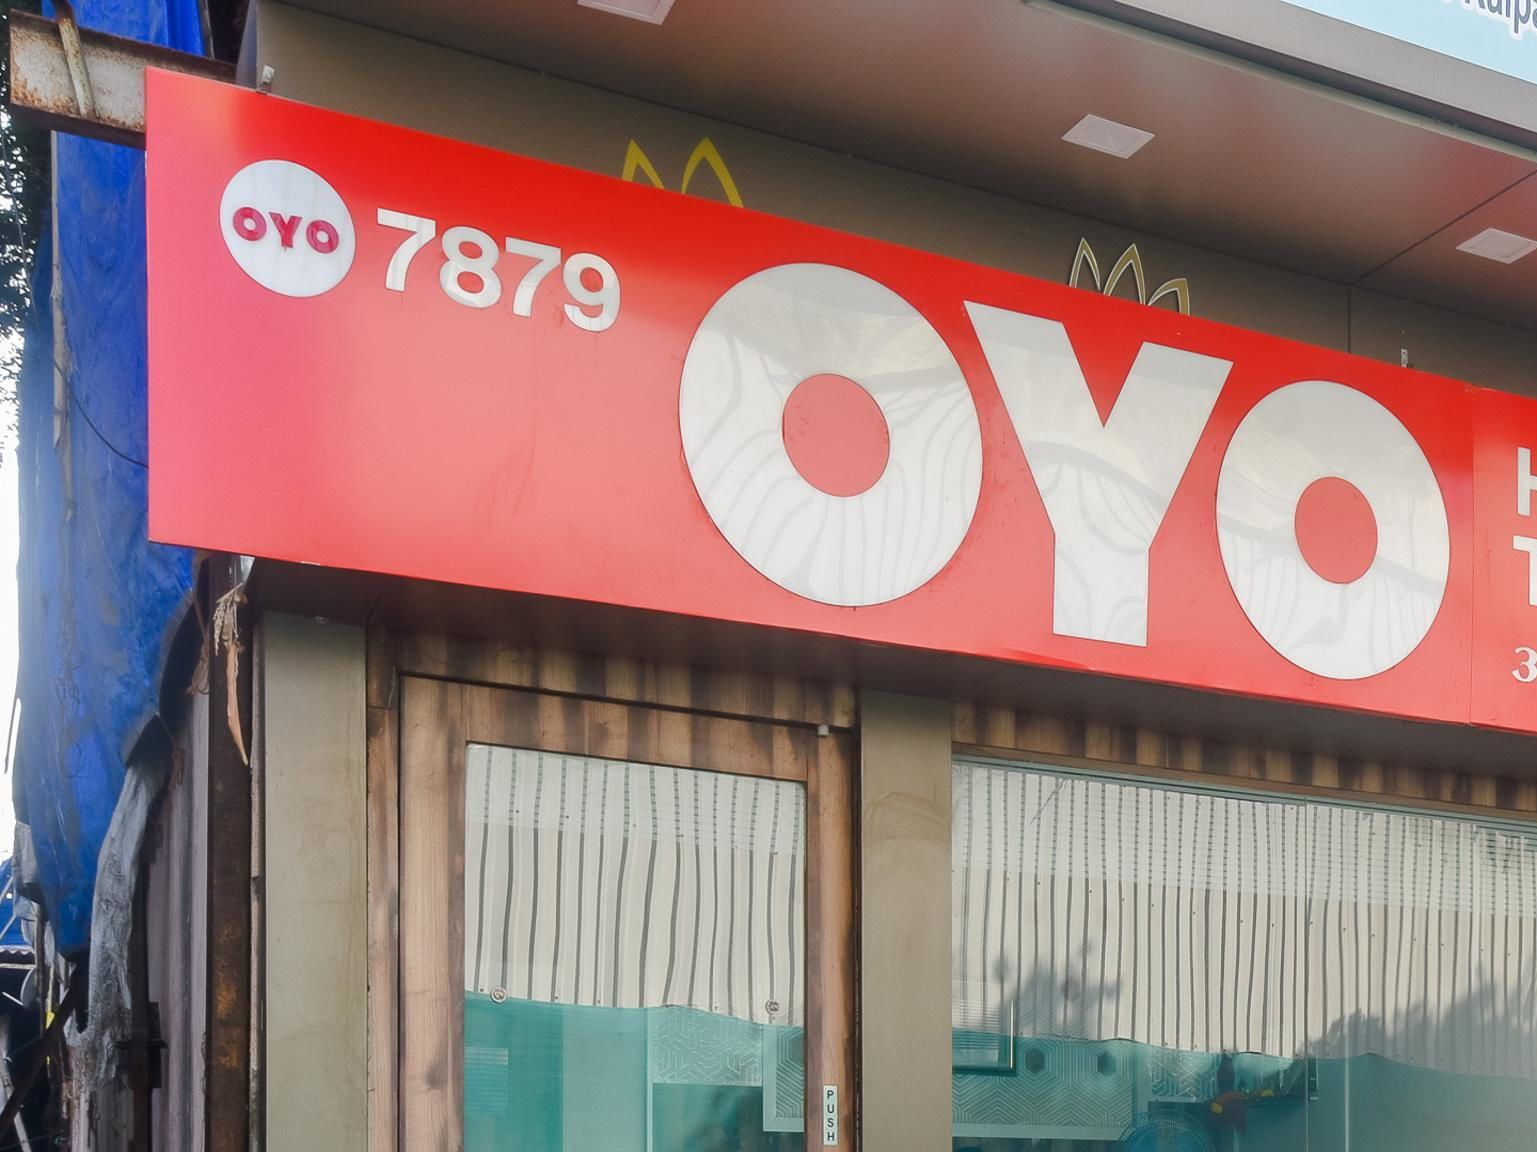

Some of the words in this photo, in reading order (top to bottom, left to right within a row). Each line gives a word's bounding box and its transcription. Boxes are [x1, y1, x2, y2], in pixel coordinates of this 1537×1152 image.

[232, 206, 340, 254] OYO
[377, 208, 621, 332] 7879
[679, 262, 1450, 680] OYO
[827, 1090, 835, 1141] PUSH
